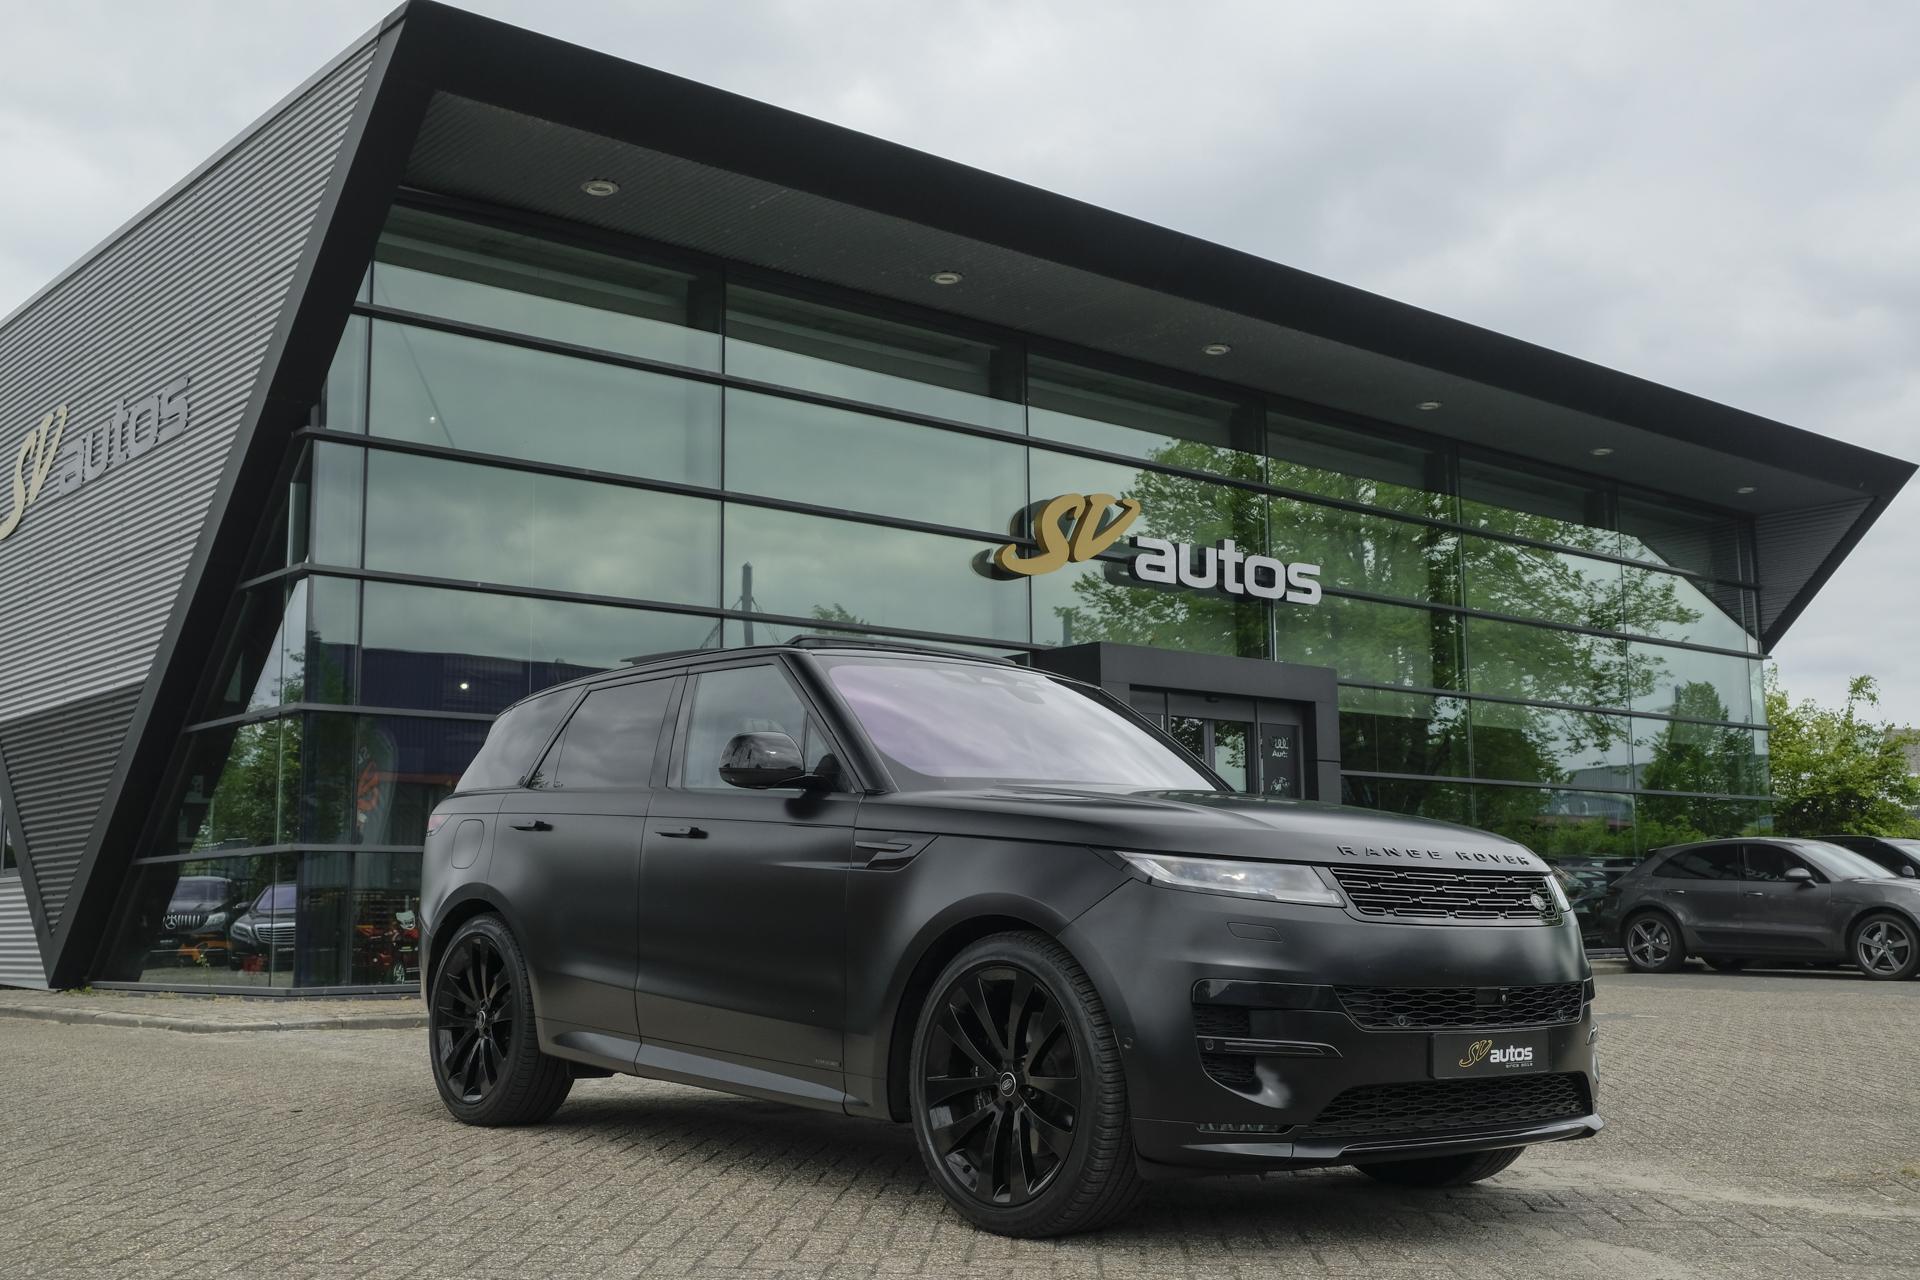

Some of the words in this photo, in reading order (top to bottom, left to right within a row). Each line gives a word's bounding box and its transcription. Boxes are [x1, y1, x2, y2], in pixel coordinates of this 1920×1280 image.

[58, 374, 190, 496] autos
[1131, 534, 1322, 605] autos
[1336, 845, 1443, 860] RANGE
[1455, 850, 1530, 866] ROVER
[1489, 1045, 1533, 1063] autos
